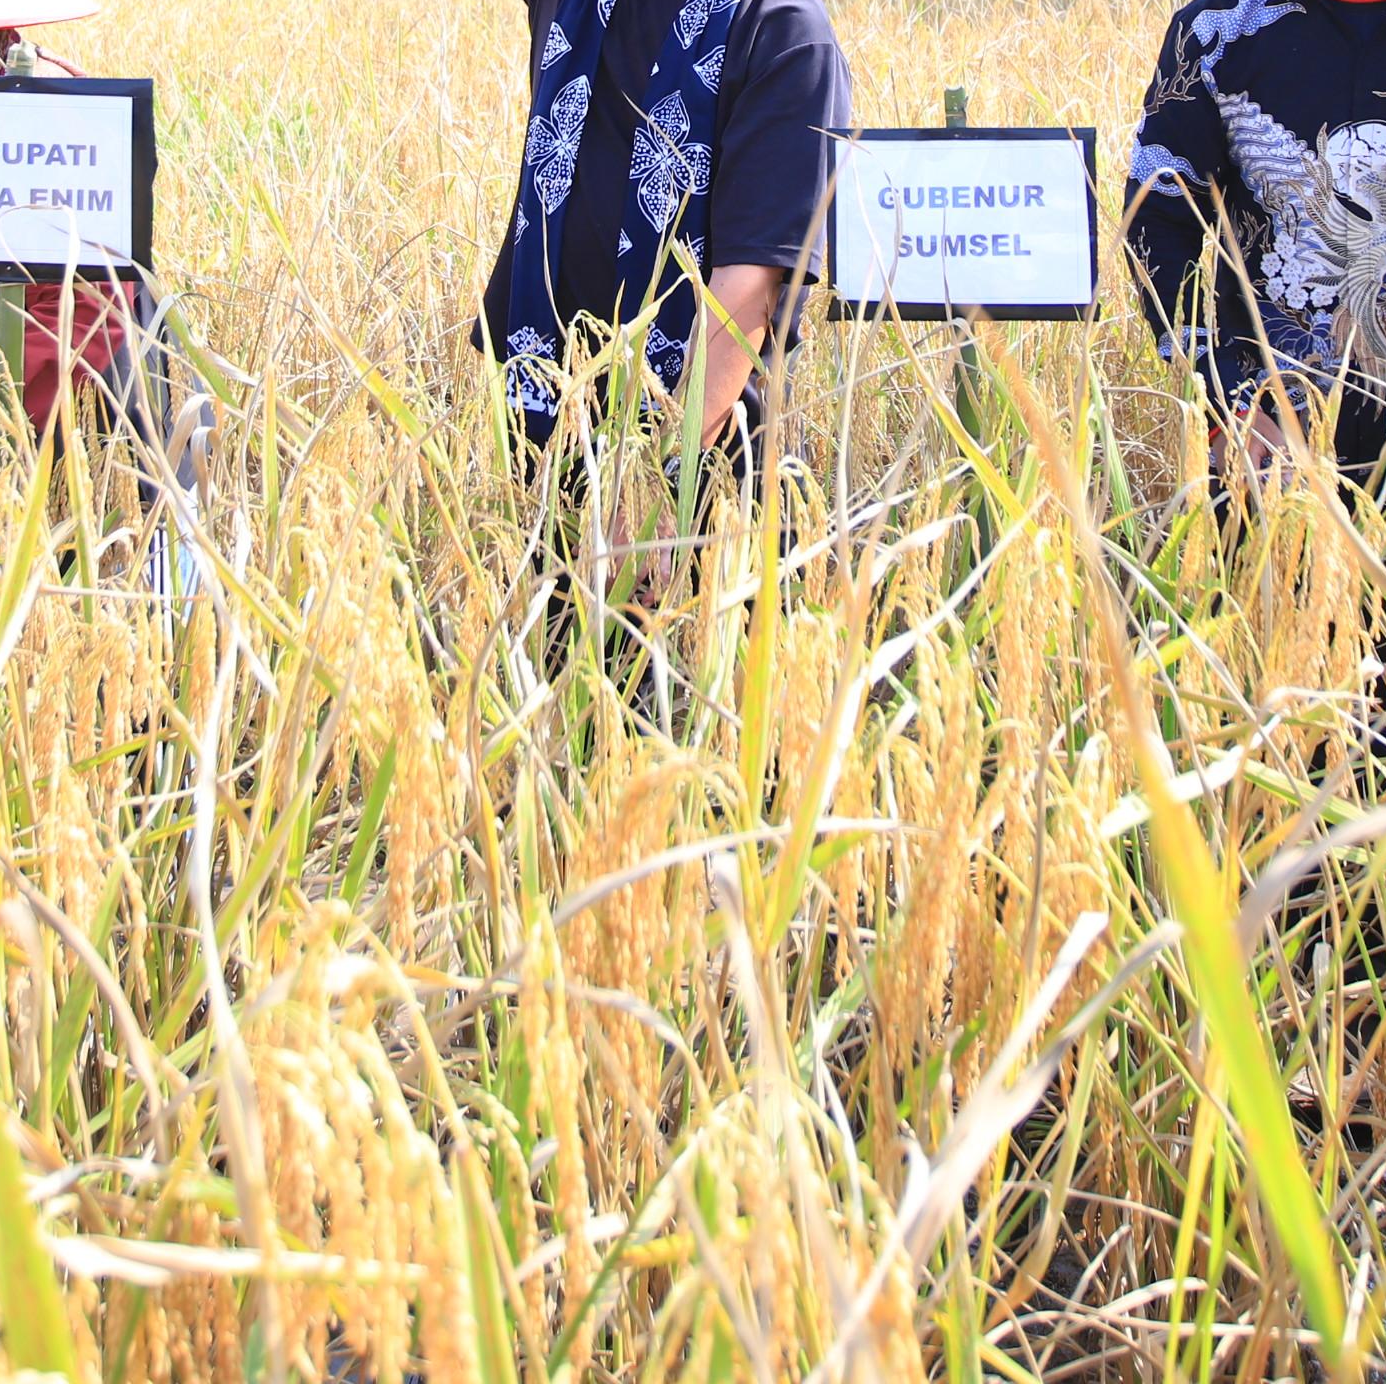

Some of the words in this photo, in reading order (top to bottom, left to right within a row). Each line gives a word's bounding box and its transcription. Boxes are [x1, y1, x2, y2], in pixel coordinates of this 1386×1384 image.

[30, 188, 113, 212] ENIM
[878, 185, 1045, 210] GUBENUR
[898, 234, 1031, 258] SUMSEL
